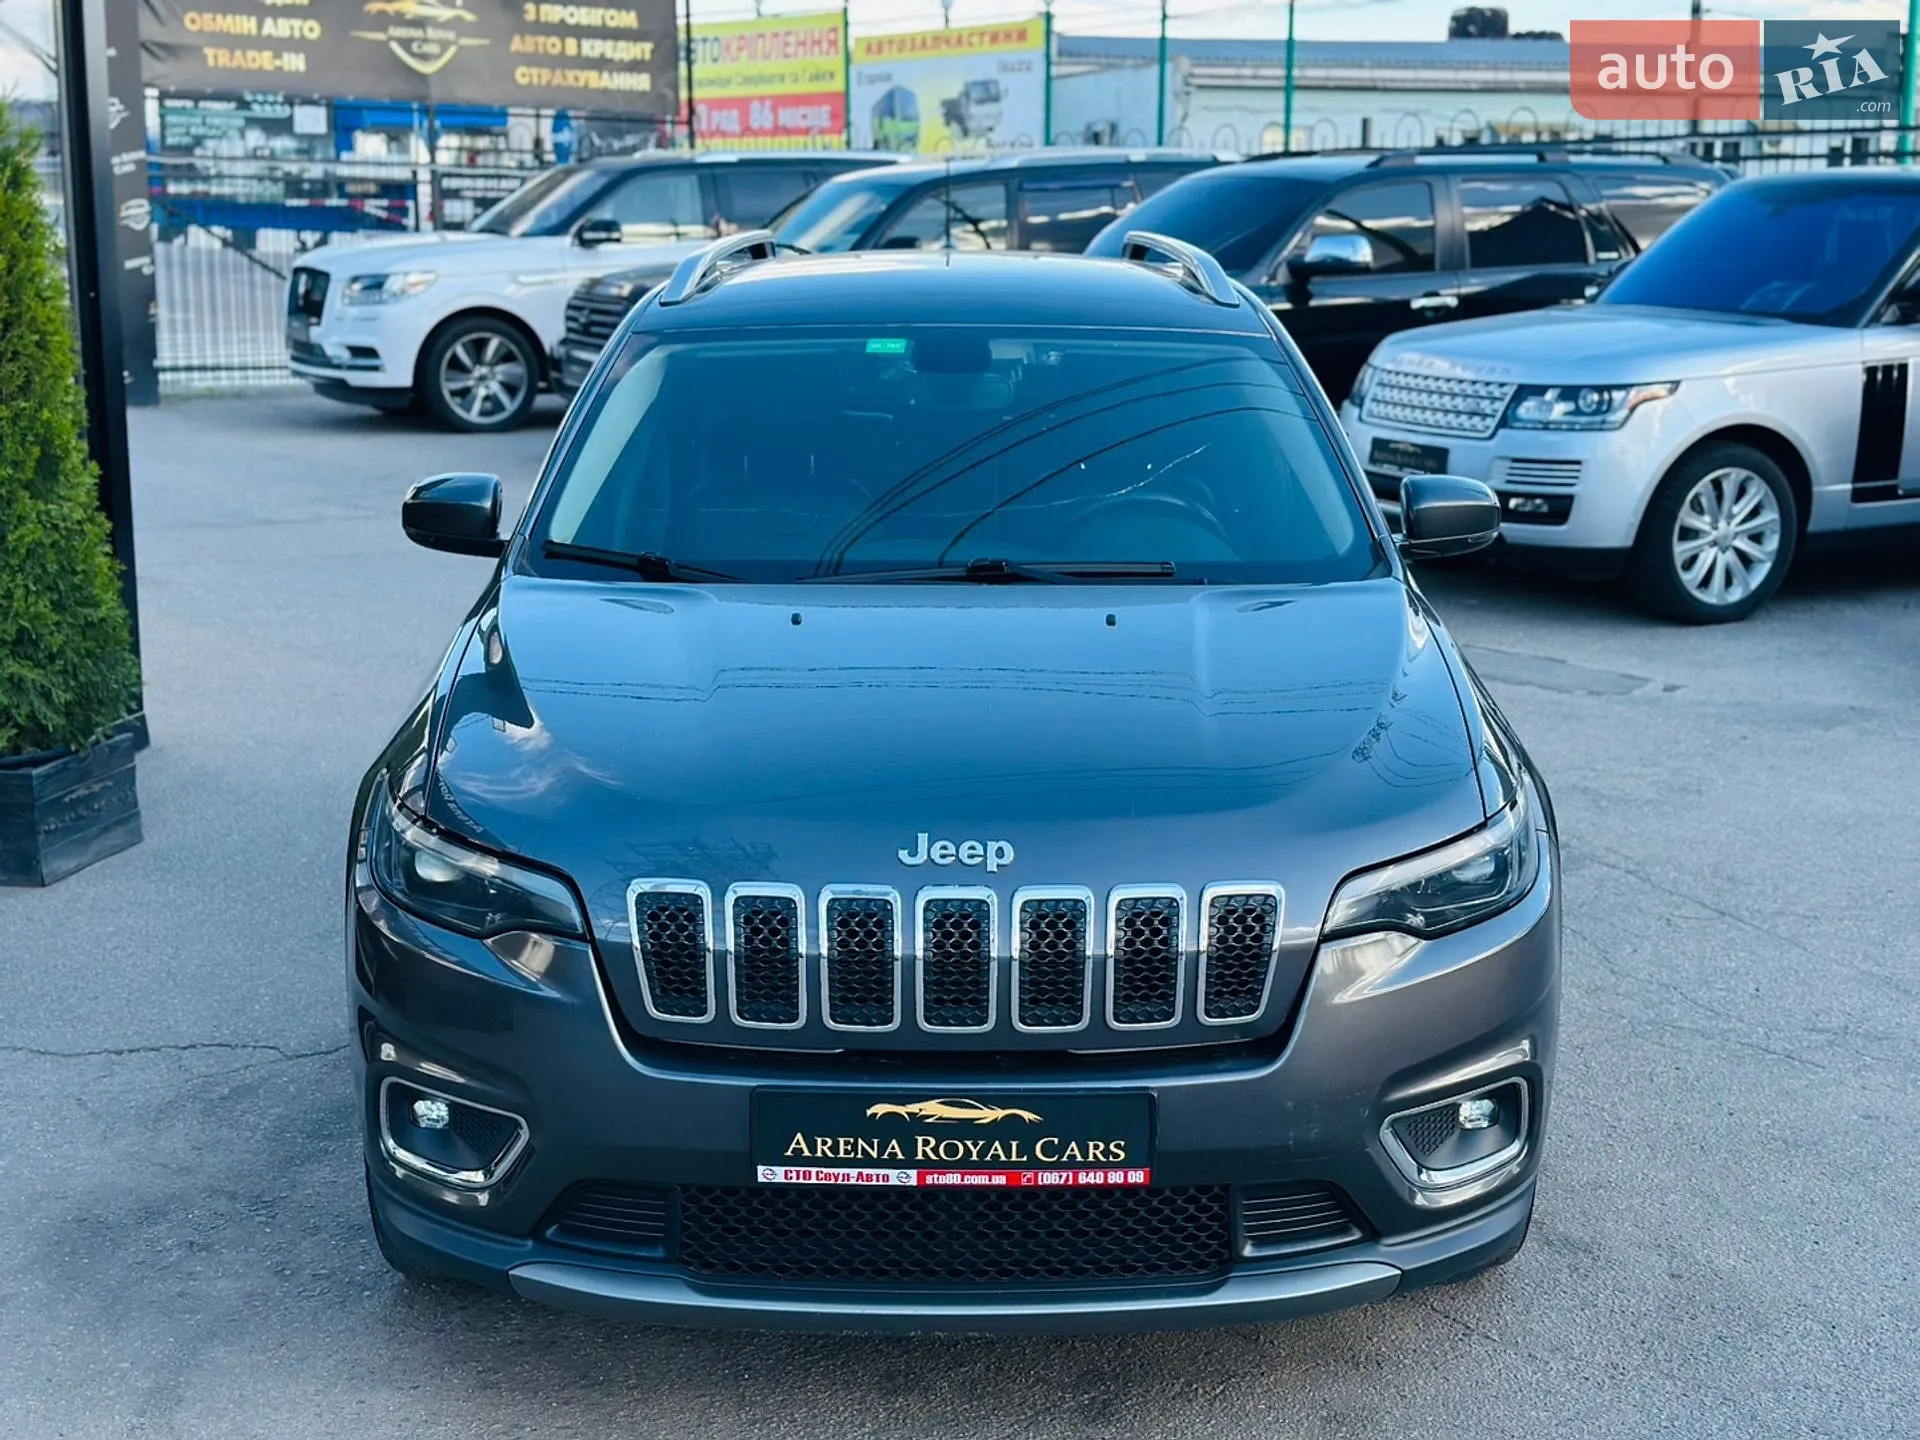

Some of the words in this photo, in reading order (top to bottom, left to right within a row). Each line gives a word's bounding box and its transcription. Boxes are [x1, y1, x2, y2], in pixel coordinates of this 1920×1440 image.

[184, 11, 258, 36] ОБМІН
[261, 16, 322, 40] АВТО
[539, 4, 638, 29] ПРОБІГОМ
[204, 47, 306, 72] TRADE-IN
[510, 34, 562, 55] АВТО
[564, 37, 578, 56] В
[580, 38, 654, 62] КРЕДИТ
[514, 66, 651, 91] СТРАХУВАННЯ
[898, 832, 1015, 873] Jeep
[784, 1132, 905, 1160] ARENA
[914, 1135, 1027, 1162] ROYAL
[1034, 1137, 1126, 1162] CARS
[784, 1169, 812, 1182] СТО
[1078, 1171, 1104, 1184] 640
